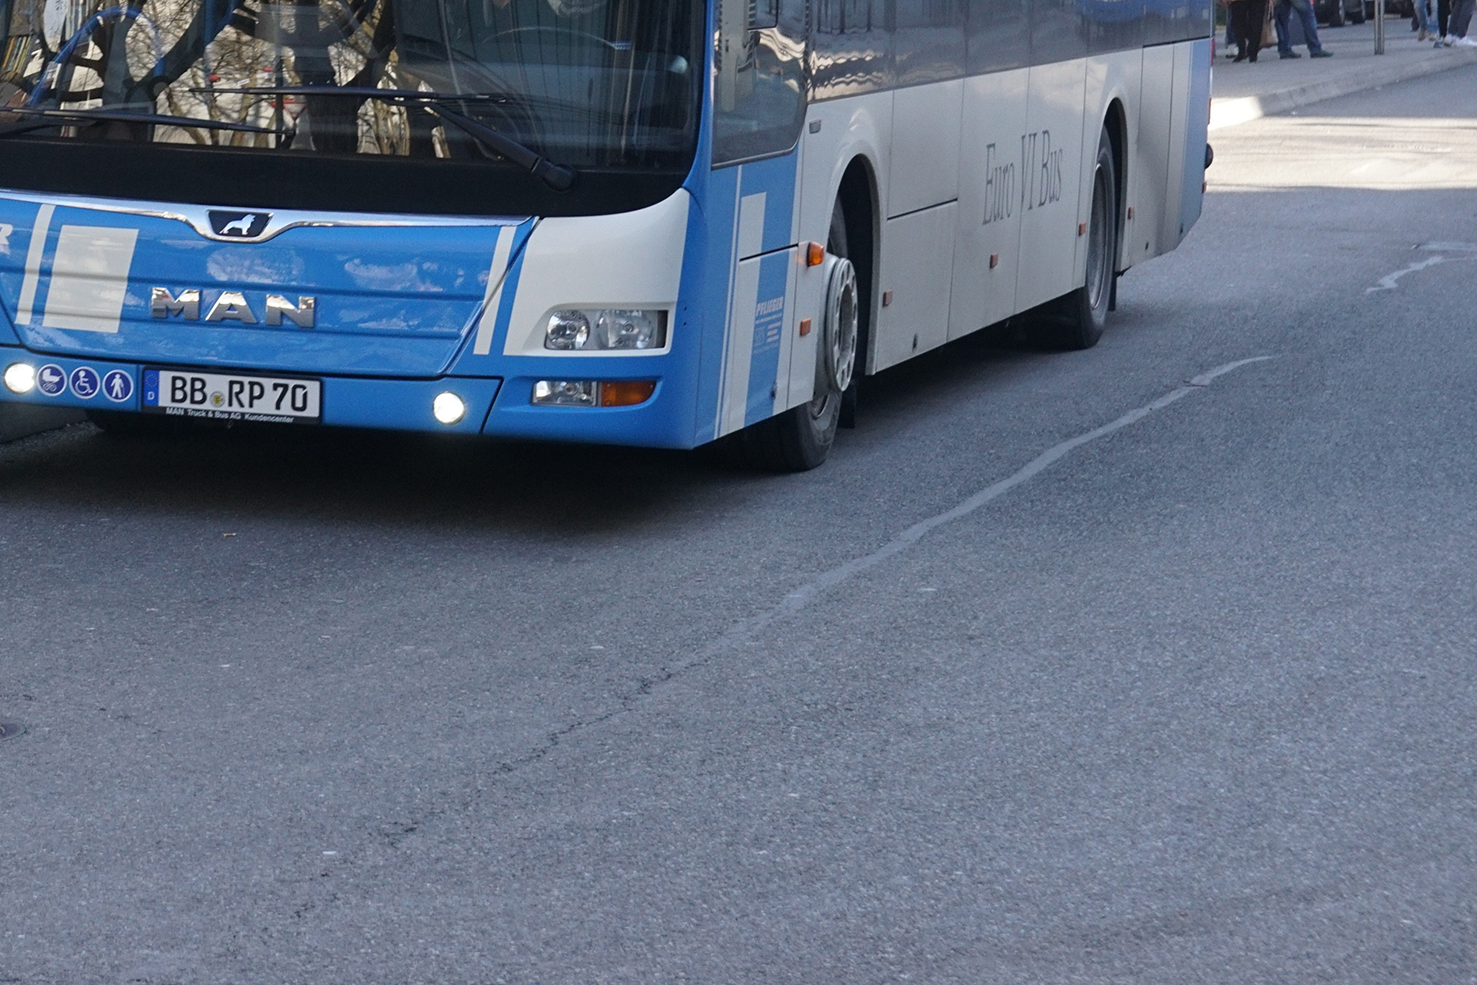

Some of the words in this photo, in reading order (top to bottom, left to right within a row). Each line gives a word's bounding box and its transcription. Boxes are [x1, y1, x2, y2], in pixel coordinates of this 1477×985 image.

[982, 143, 1015, 225] Euro
[1020, 132, 1037, 213] VI
[1038, 129, 1063, 207] Bus
[150, 286, 317, 329] MAN
[147, 391, 155, 400] D
[170, 375, 207, 405] BB
[228, 379, 265, 409] RP
[272, 382, 308, 412] 70
[165, 406, 184, 415] MAN
[187, 409, 206, 417] Truck
[214, 410, 228, 419] Bus
[229, 412, 241, 420] AG
[244, 413, 294, 423] Kundencenter
